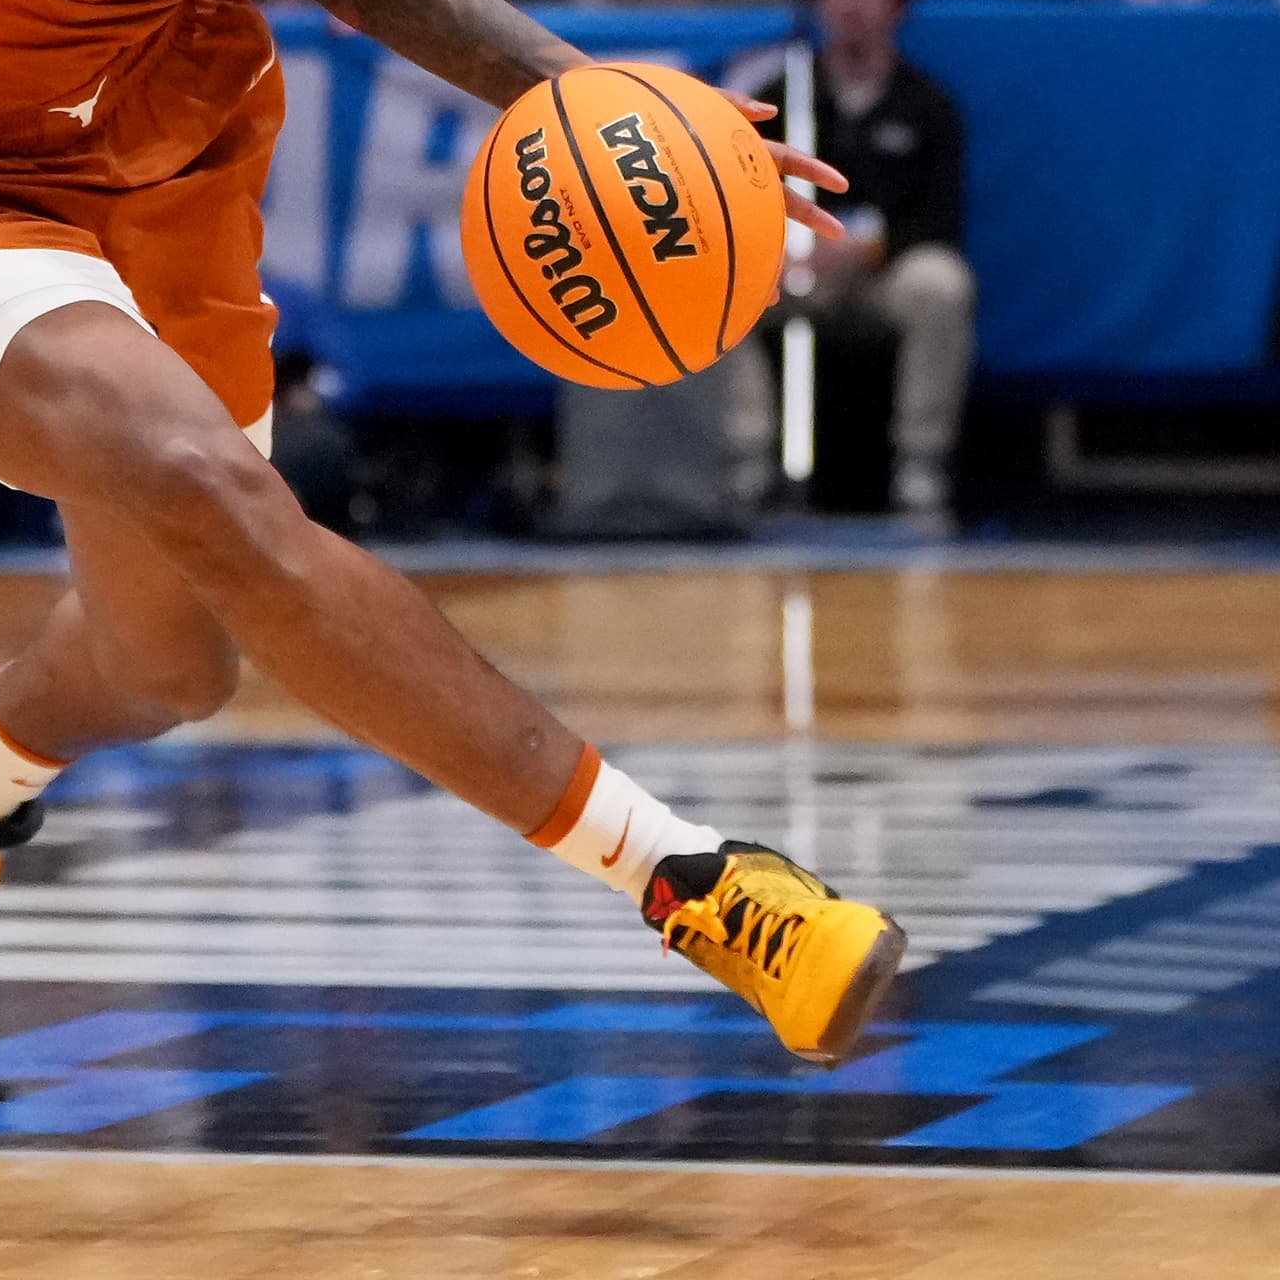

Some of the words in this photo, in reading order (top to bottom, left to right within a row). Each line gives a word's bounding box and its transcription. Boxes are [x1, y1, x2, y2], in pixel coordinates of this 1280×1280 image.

[515, 126, 619, 341] Wilson
[559, 188, 576, 216] NXT
[598, 112, 699, 264] NCAA
[572, 219, 592, 250] EVO
